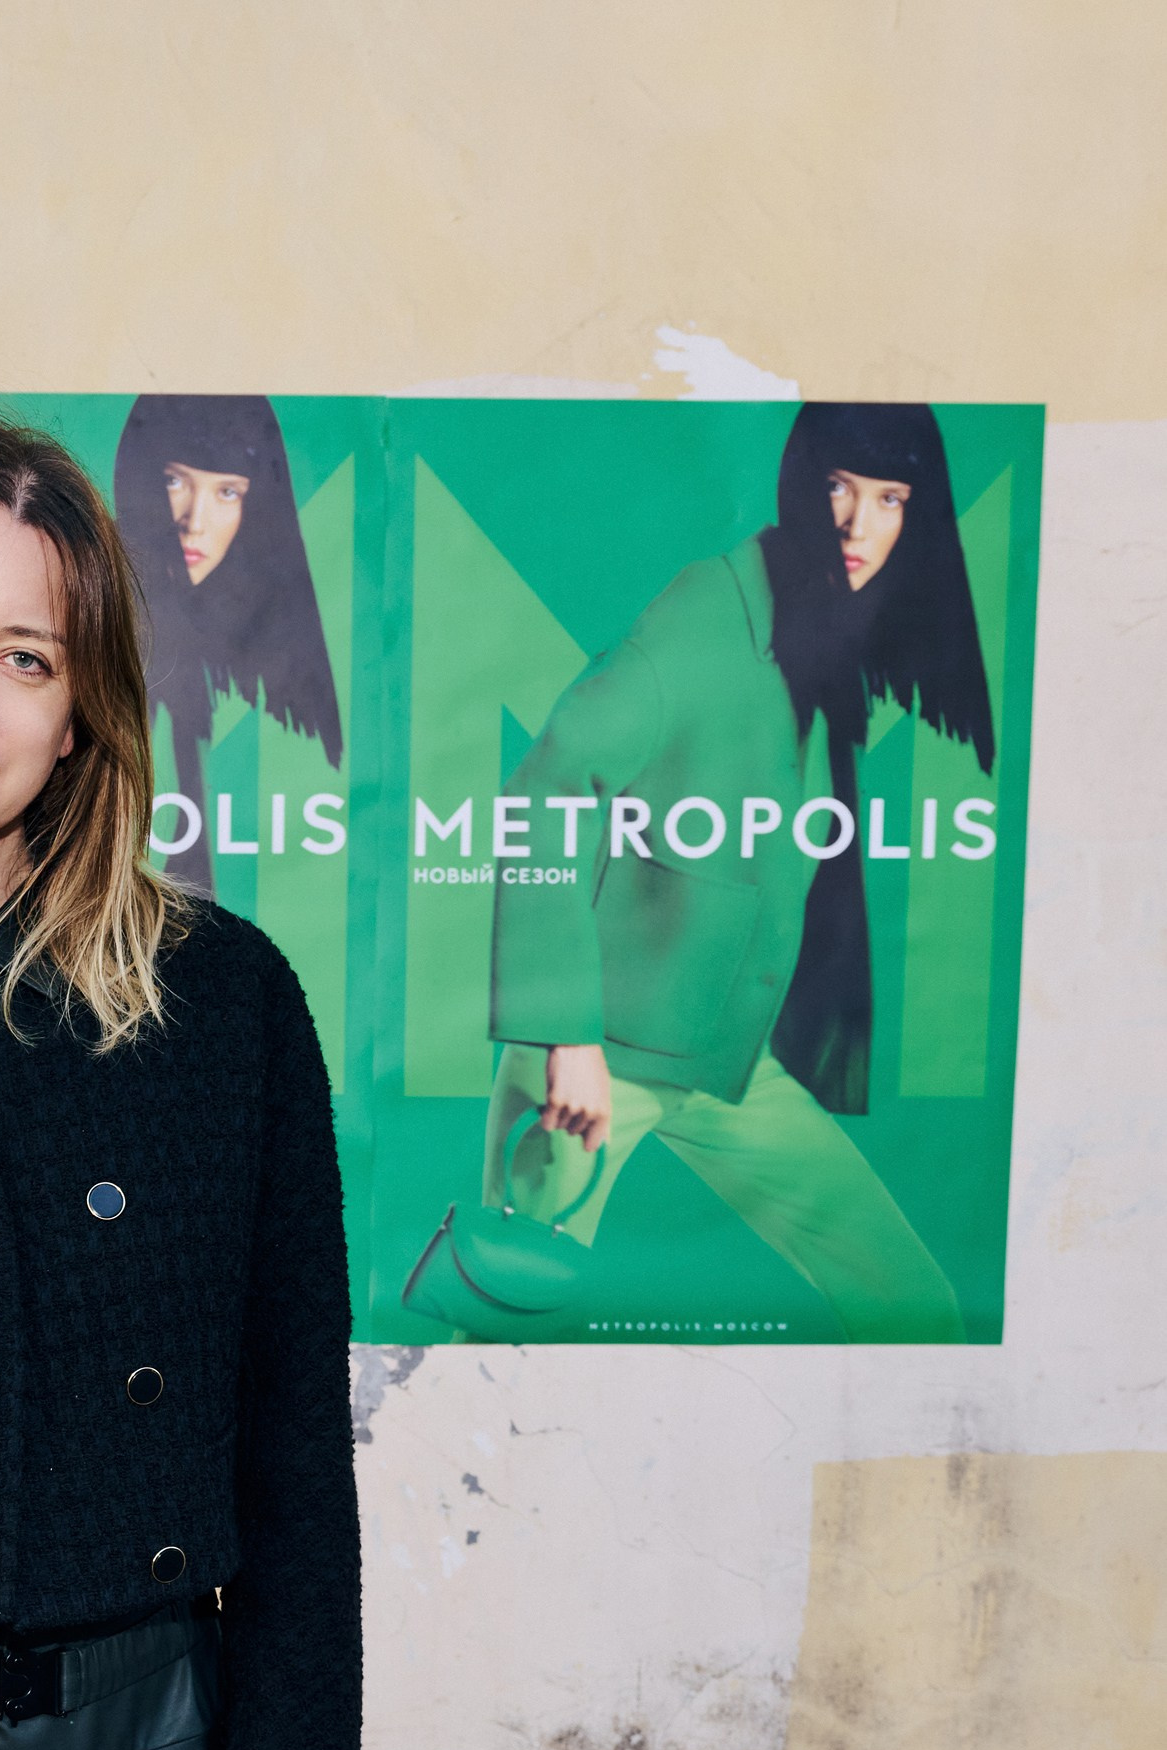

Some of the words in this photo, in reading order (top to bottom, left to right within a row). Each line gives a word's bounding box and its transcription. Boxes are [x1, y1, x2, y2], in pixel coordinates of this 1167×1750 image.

[413, 796, 997, 860] METROPOLIS
[413, 863, 495, 885] НОВЫЙ
[501, 866, 577, 885] СЕЗОН
[589, 1321, 787, 1332] METROPOLIS.MOSCOW
